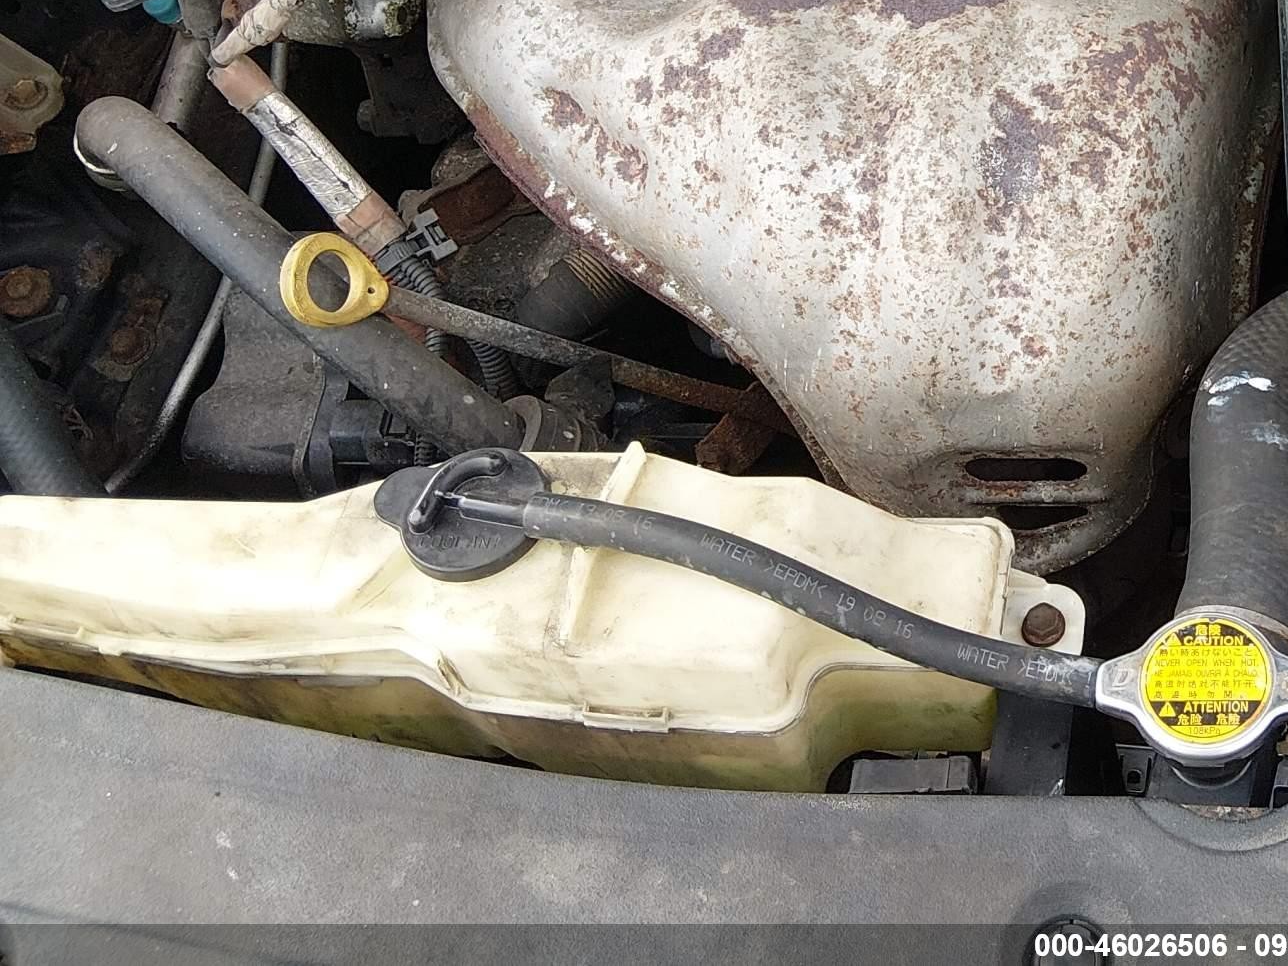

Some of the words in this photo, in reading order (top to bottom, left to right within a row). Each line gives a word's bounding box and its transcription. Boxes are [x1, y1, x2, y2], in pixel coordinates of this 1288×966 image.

[701, 533, 758, 566] WATER
[835, 592, 856, 611] 19
[896, 619, 914, 639] 16
[1183, 635, 1244, 646] CAUTION
[957, 642, 1009, 672] WATER
[1154, 658, 1180, 667] NEVER
[1186, 658, 1208, 667] OPEN
[1213, 658, 1236, 667] WHEN
[1195, 669, 1221, 677] OUVRIR
[1183, 701, 1249, 713] ATTENTION
